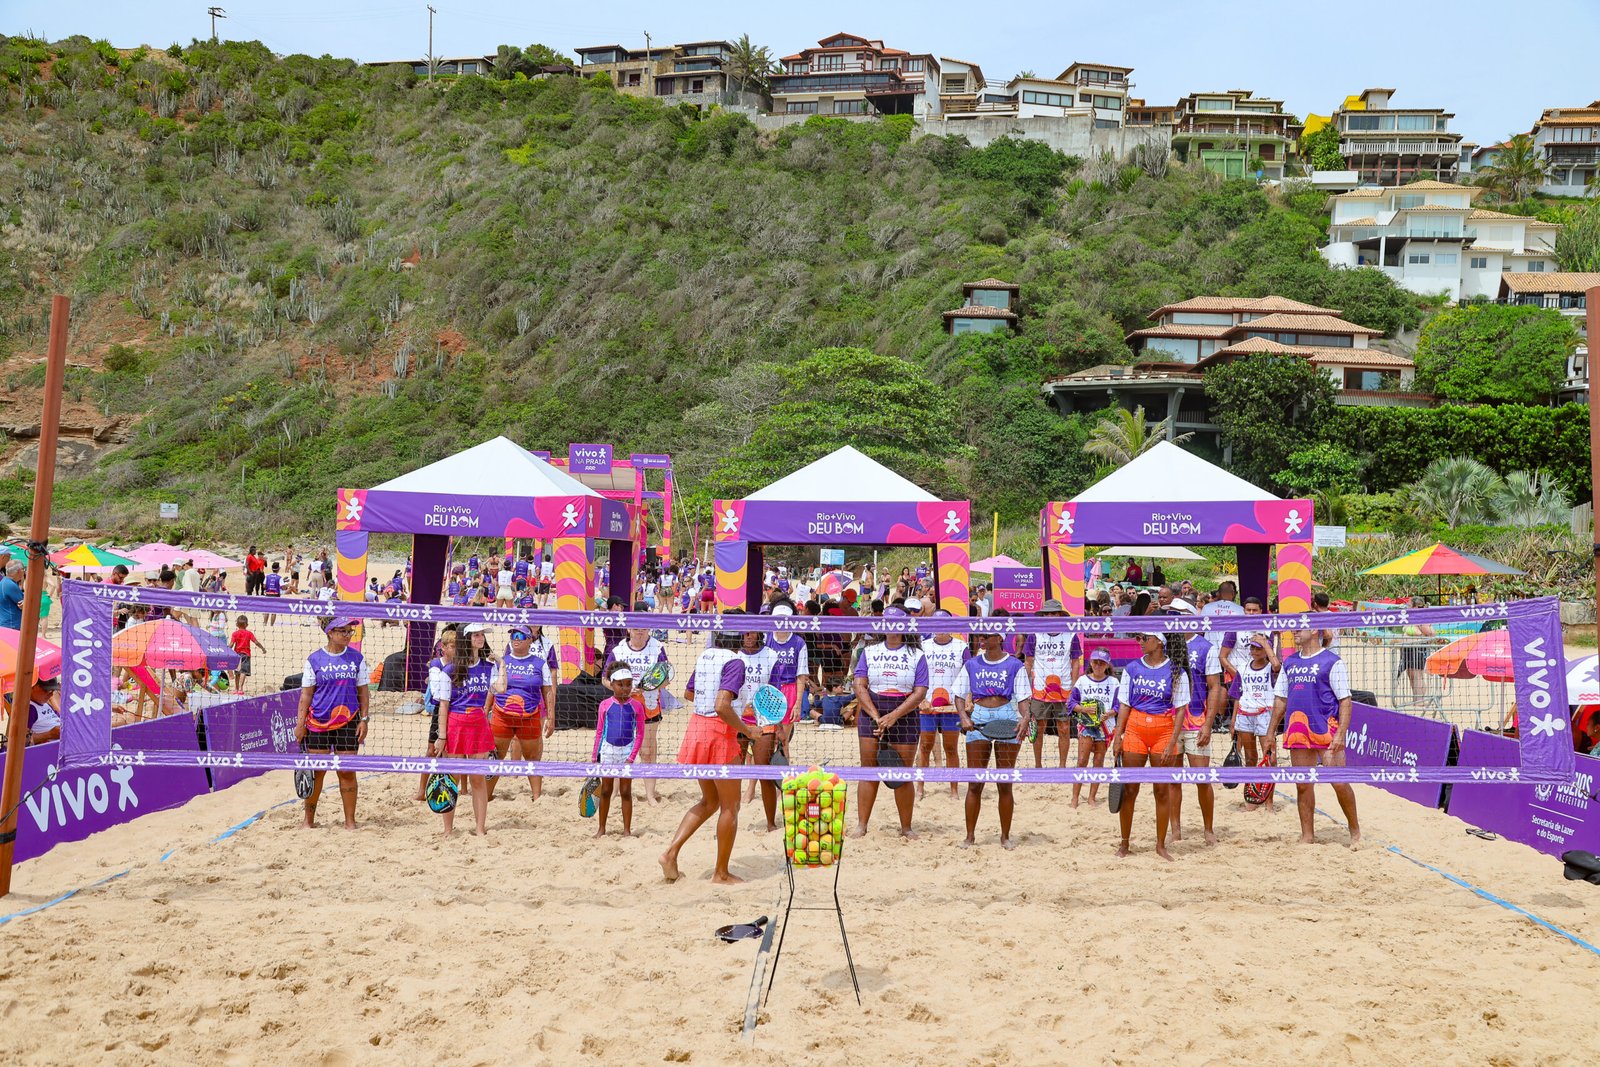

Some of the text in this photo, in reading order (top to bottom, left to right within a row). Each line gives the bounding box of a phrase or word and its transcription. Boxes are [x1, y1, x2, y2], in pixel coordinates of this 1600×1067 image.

[575, 448, 597, 457] vivo
[425, 514, 479, 528] DEU BOM
[808, 522, 864, 535] DEU BOM
[1144, 522, 1201, 535] DEU BOM
[93, 585, 126, 600] vivo
[191, 591, 225, 607] vivo
[289, 600, 322, 614] vivo
[386, 603, 419, 619] vivo
[1011, 601, 1035, 609] KITS
[1460, 605, 1495, 618] vivo
[482, 607, 516, 623] vivo
[580, 611, 613, 626] vivo
[677, 613, 710, 629] vivo
[1262, 615, 1296, 629] vivo
[1361, 611, 1396, 625] vivo
[774, 615, 808, 630] vivo
[872, 616, 905, 631] vivo
[969, 617, 1003, 631] vivo
[1067, 617, 1100, 631] vivo
[1164, 617, 1198, 631] vivo
[72, 617, 102, 687] vivo
[873, 653, 899, 662] vivo
[926, 652, 948, 661] vivo
[320, 663, 349, 672] vivo
[883, 663, 909, 671] PRAIA
[975, 669, 999, 679] vivo
[1287, 665, 1309, 676] vivo
[1523, 637, 1557, 709] vivo
[322, 673, 334, 681] NA
[463, 677, 479, 687] ivo
[1132, 675, 1156, 687] vivo
[1294, 675, 1317, 684] PRAIA
[468, 685, 489, 693] PRAIA
[985, 680, 1006, 690] PRAIA
[1083, 686, 1103, 695] vivo
[1140, 688, 1163, 700] PRAIA
[1345, 729, 1402, 766] vo NA PRAIA
[99, 752, 132, 766] vivo
[197, 753, 230, 767] vivo
[294, 755, 327, 769] vivo
[391, 758, 425, 772] vivo
[488, 761, 523, 775] vivo
[585, 764, 619, 778] vivo
[682, 766, 716, 778] vivo
[878, 768, 911, 781] vivo
[975, 768, 1009, 782] vivo
[1471, 767, 1507, 781] vivo
[1073, 769, 1107, 782] vivo
[1172, 769, 1206, 782] vivo
[1271, 769, 1305, 783] vivo
[1370, 768, 1405, 783] vivo
[23, 764, 109, 832] vivo
[1555, 793, 1588, 809] PREFEITURA
[1531, 815, 1575, 836] Secretaria de Lazer
[1536, 828, 1565, 844] e do Esporte
